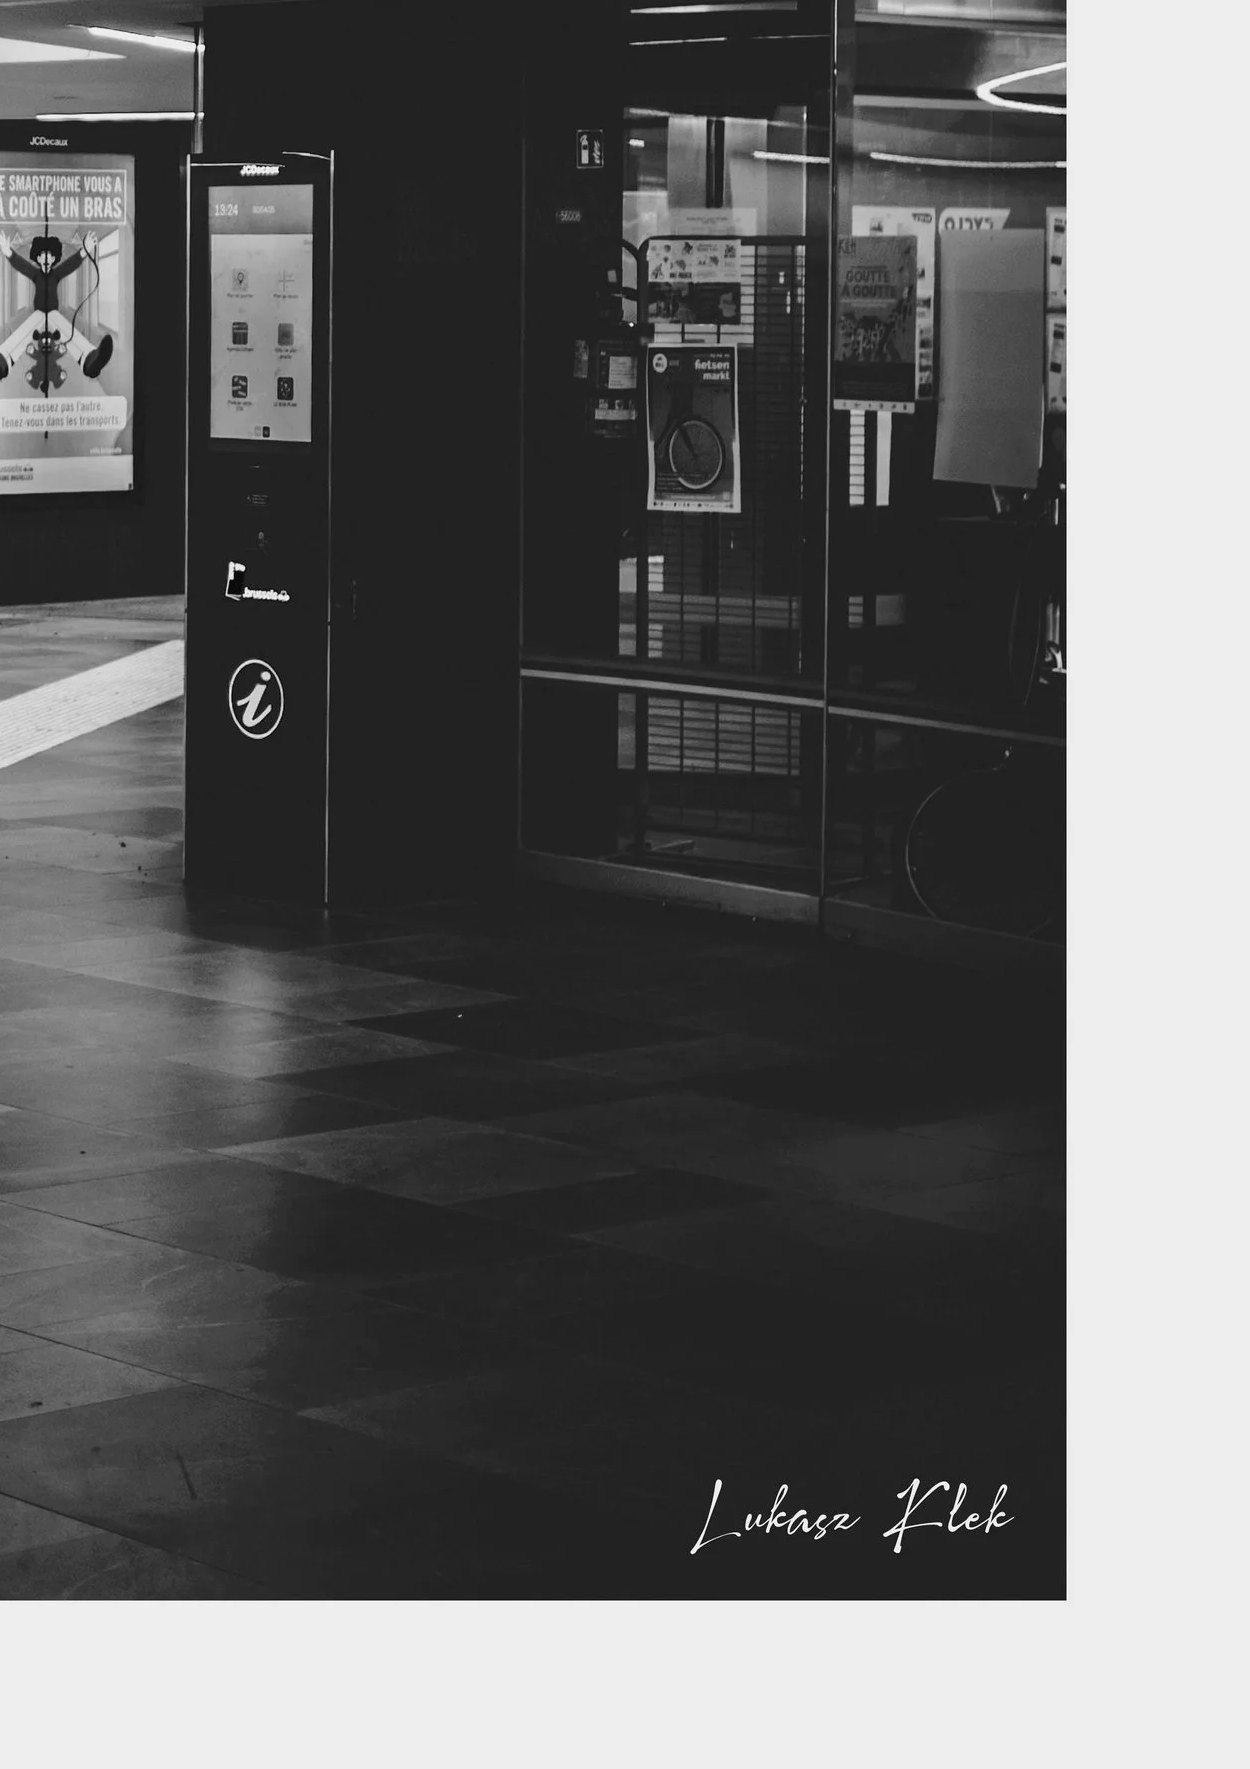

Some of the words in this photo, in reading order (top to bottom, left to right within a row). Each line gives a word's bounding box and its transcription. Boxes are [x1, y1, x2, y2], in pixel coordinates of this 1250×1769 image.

[29, 135, 69, 147] JCDecaux
[8, 174, 81, 193] SMARTPHONE
[83, 175, 112, 193] VOUS
[113, 176, 123, 193] A
[8, 191, 55, 219] COÛTÉ
[59, 196, 80, 219] UN
[83, 195, 123, 220] BRAS
[845, 270, 890, 283] GOUTTE
[852, 284, 897, 298] GOUTTE
[694, 358, 730, 371] fietsen
[702, 371, 731, 381] markt
[19, 402, 30, 413] Ne
[32, 402, 59, 413] cassez
[60, 402, 75, 413] pas
[1, 416, 44, 429] Tenez-vous
[45, 415, 65, 427] dans
[66, 415, 78, 427] les
